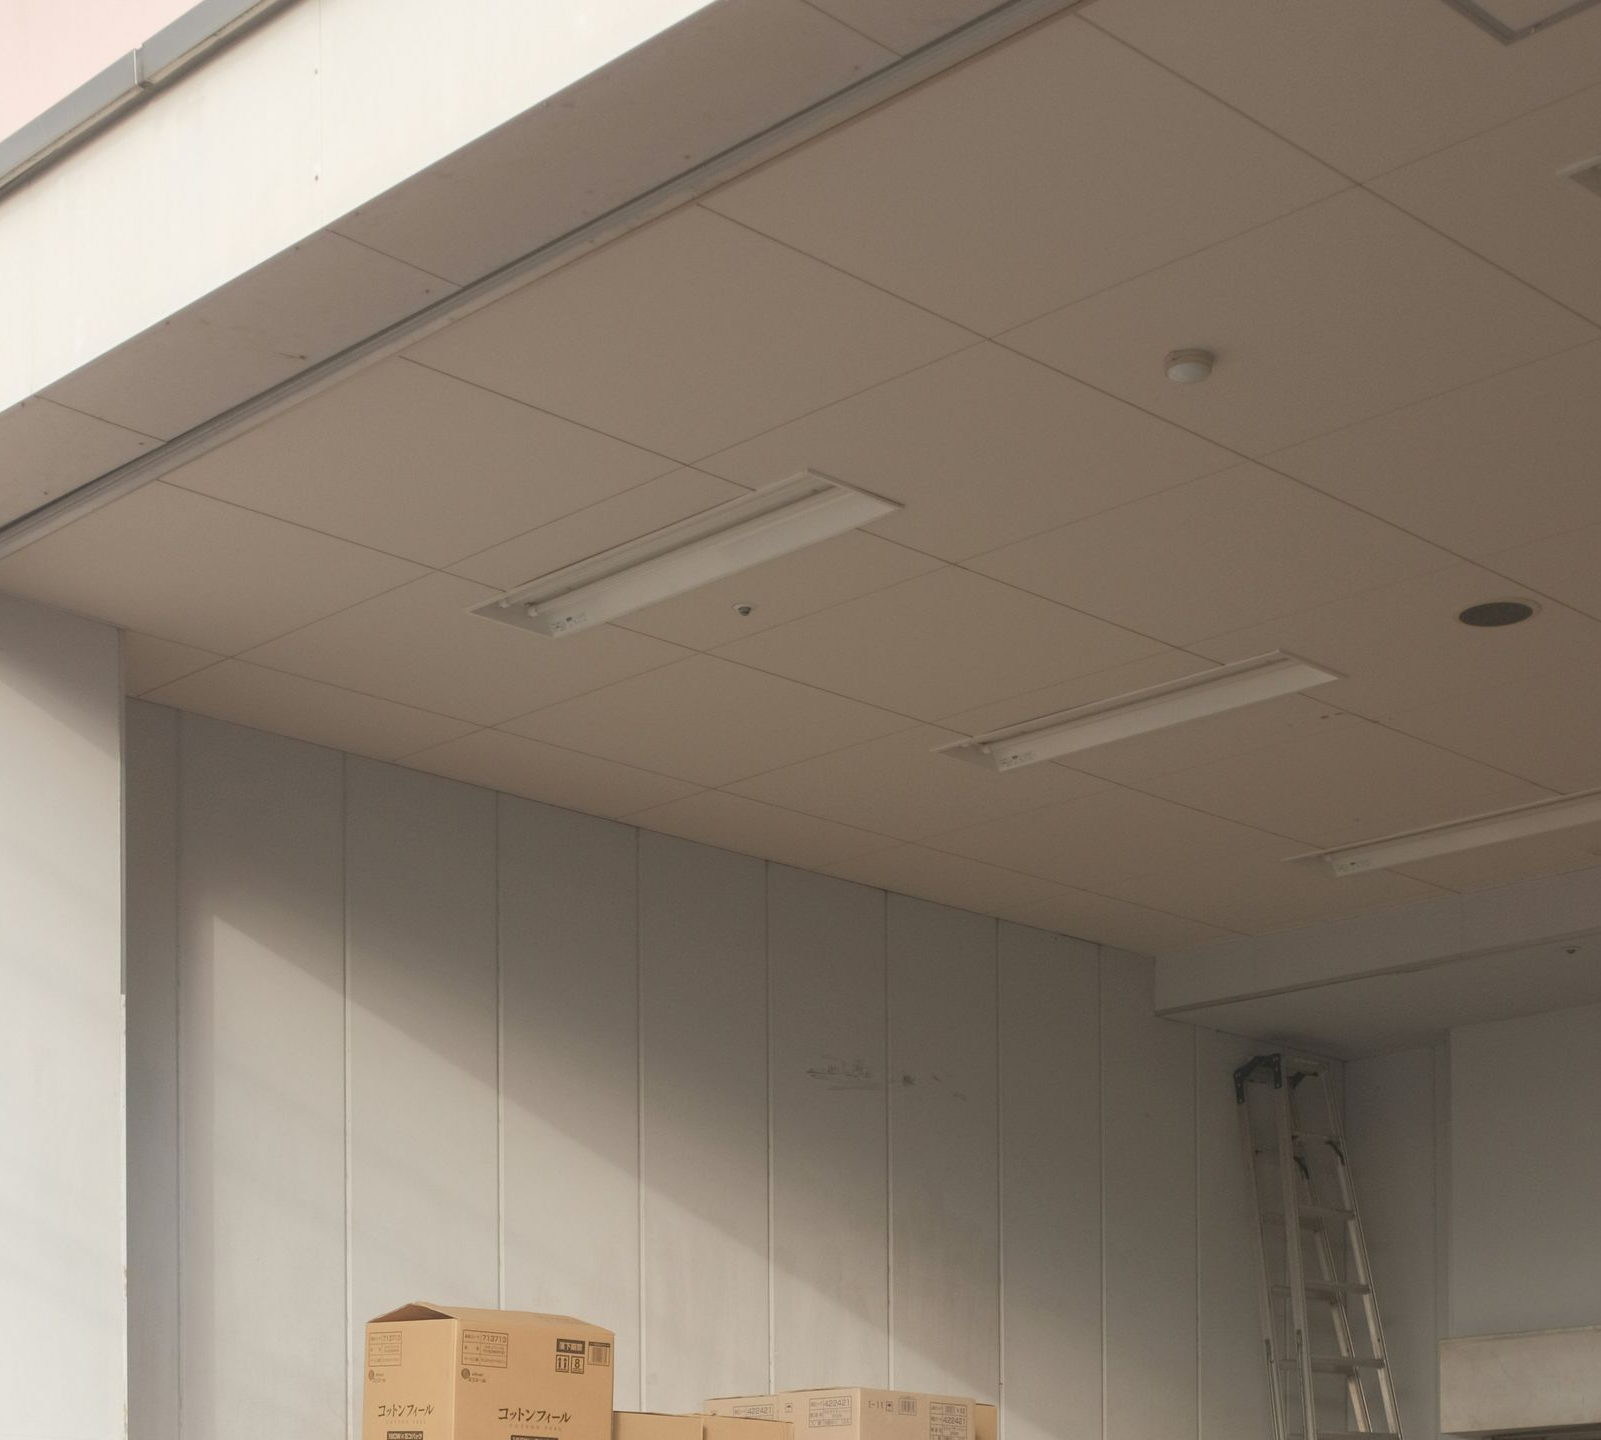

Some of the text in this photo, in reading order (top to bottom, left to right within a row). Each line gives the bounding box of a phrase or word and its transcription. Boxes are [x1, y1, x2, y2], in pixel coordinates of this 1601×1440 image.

[378, 1403, 435, 1418] コットンフィール
[498, 1407, 572, 1424] コットンフィール
